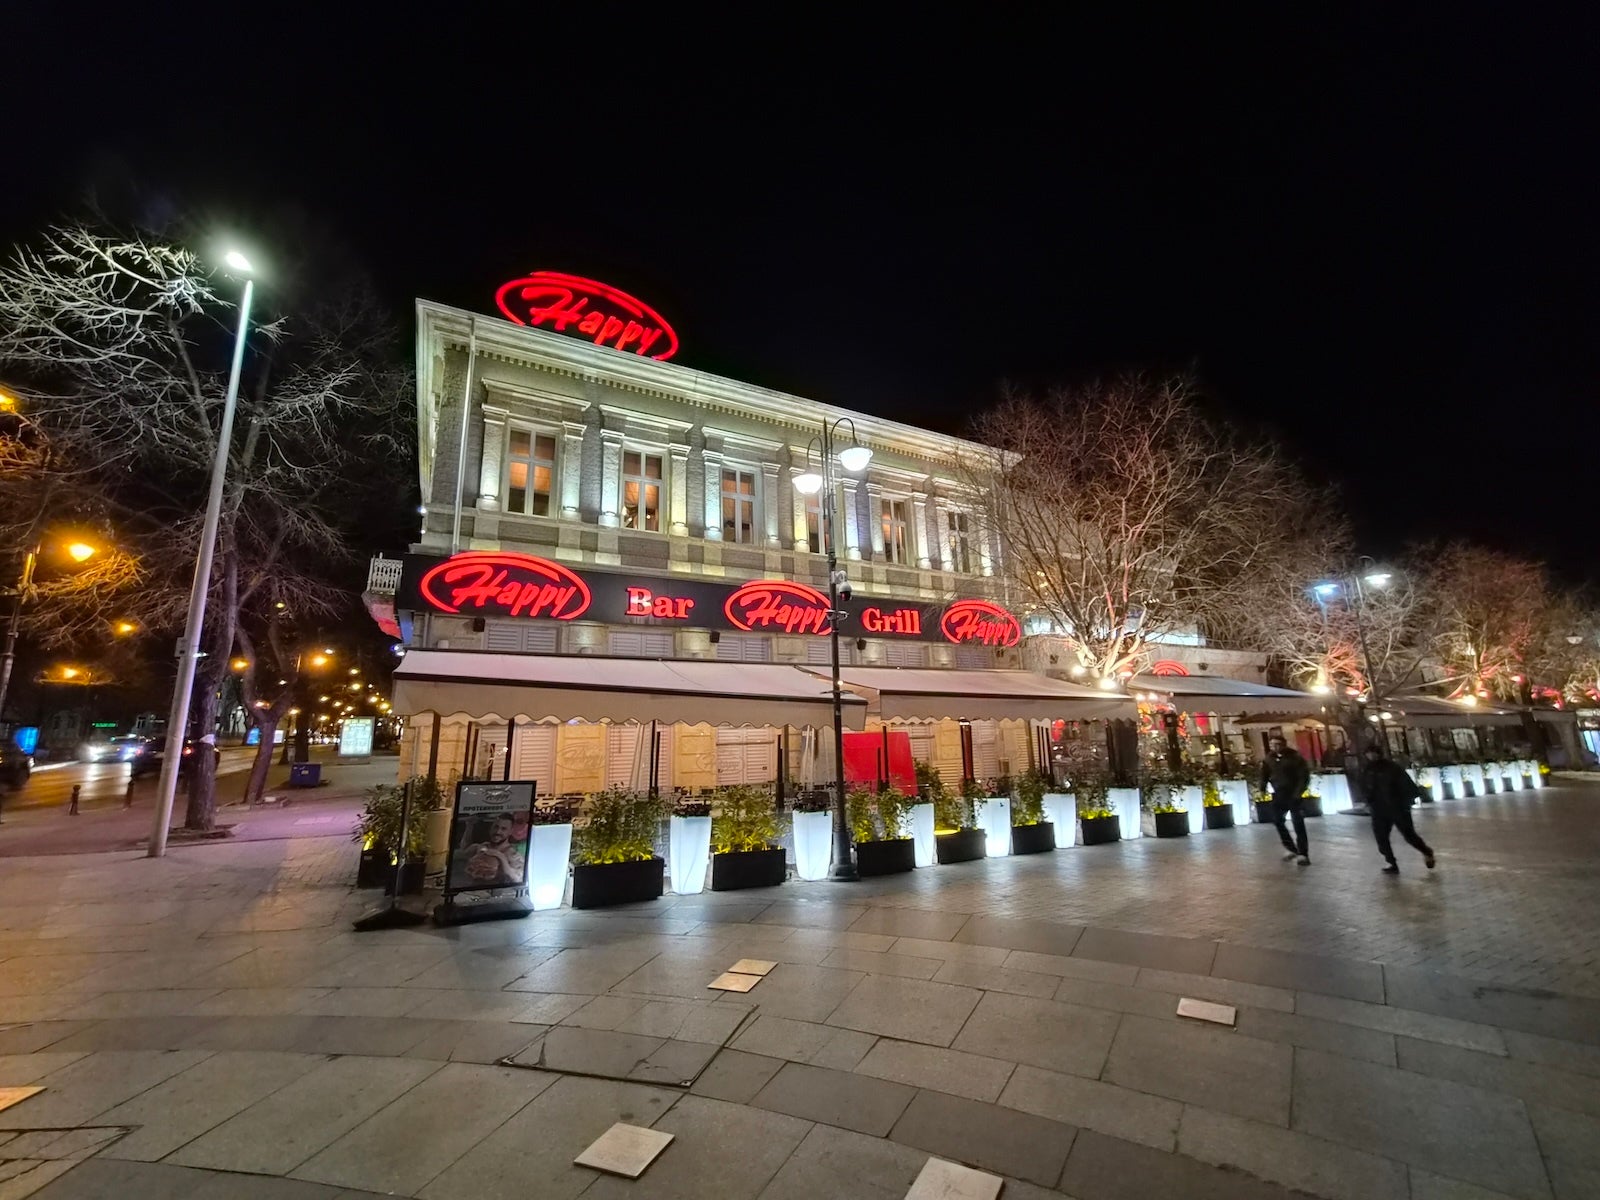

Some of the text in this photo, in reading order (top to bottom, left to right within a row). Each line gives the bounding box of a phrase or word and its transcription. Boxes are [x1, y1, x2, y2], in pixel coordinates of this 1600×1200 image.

[521, 287, 663, 356] Happy
[444, 565, 1013, 646] Happy Bar Happy Grill Happy
